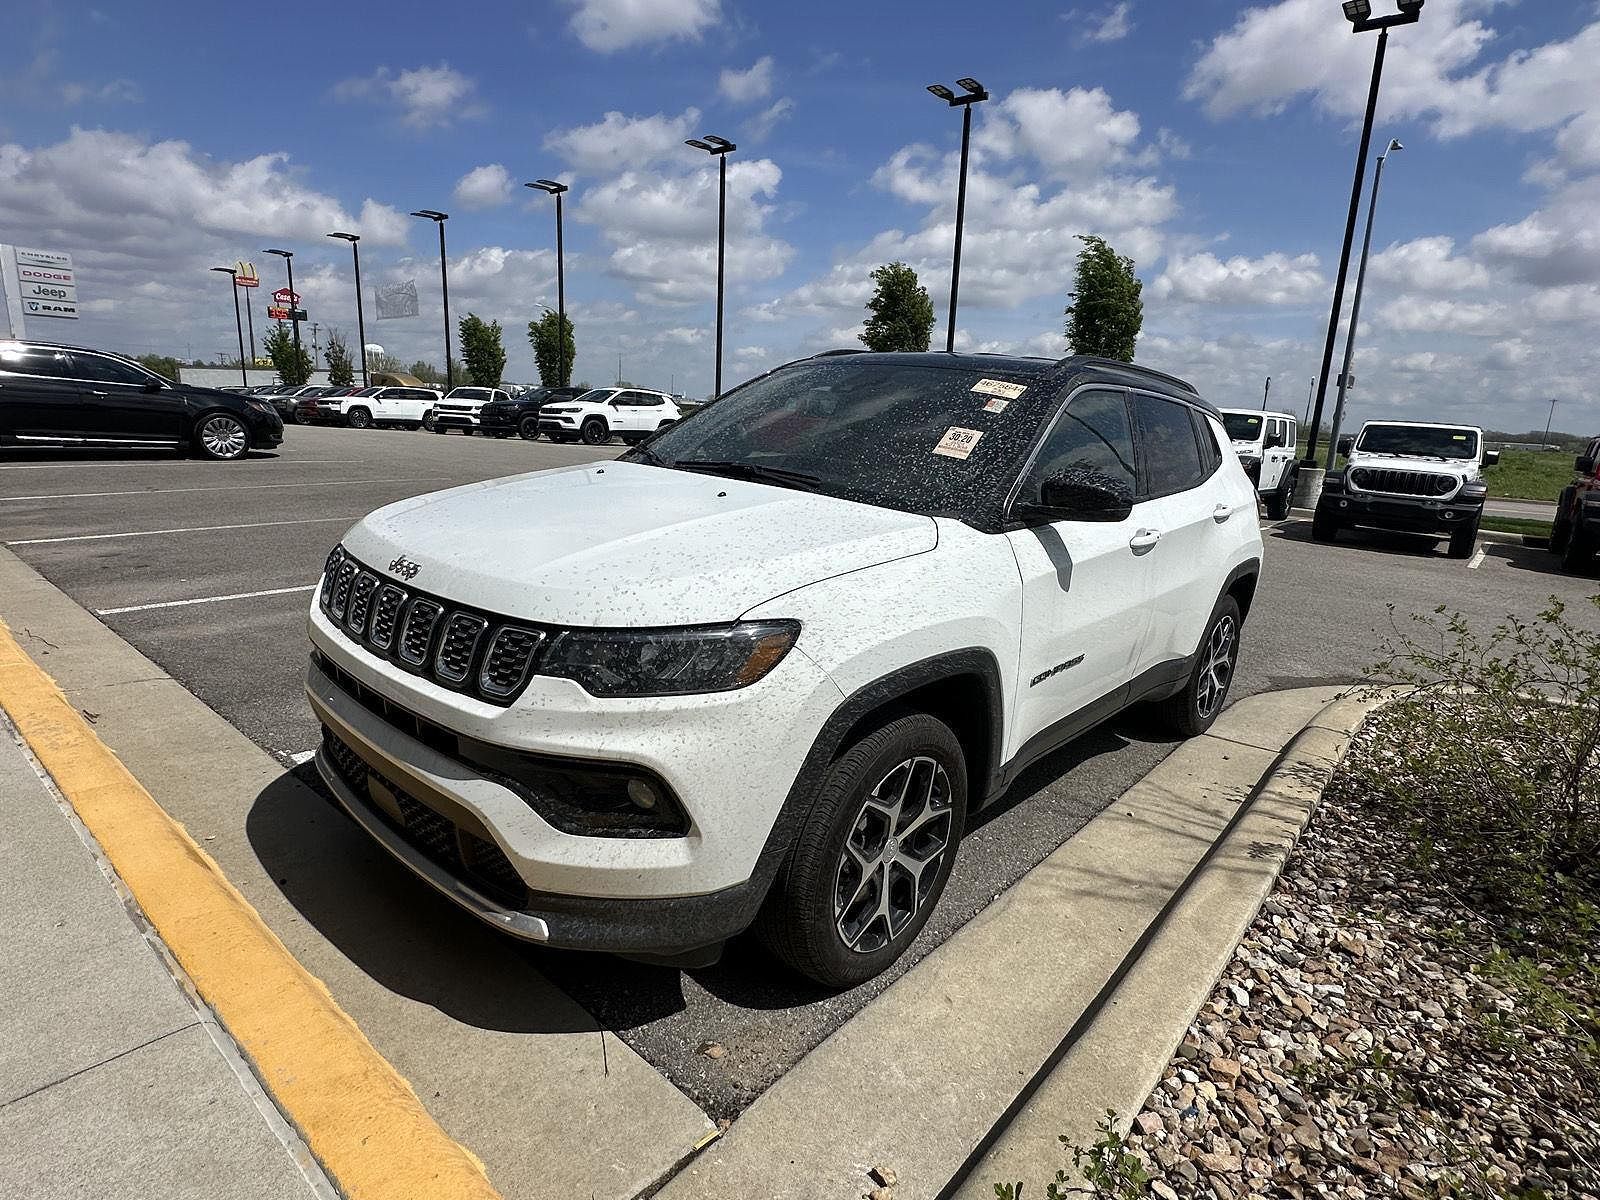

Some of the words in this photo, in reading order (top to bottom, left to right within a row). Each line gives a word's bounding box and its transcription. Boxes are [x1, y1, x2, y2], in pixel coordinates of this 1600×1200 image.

[22, 270, 71, 281] DODGE
[32, 285, 67, 299] Jeep
[275, 293, 298, 302] Case's
[42, 305, 76, 313] RAM
[388, 554, 422, 581] Jeep
